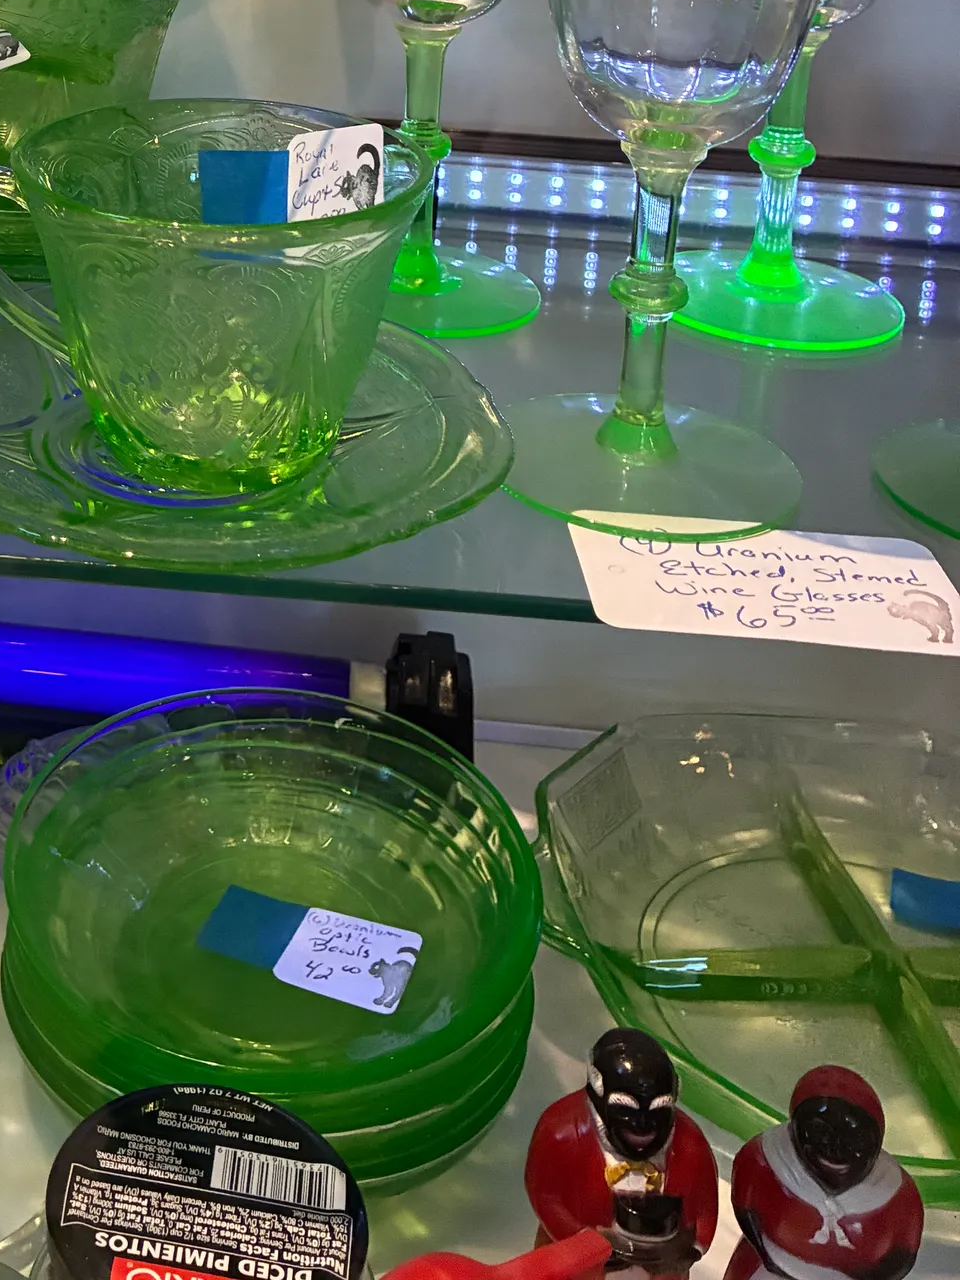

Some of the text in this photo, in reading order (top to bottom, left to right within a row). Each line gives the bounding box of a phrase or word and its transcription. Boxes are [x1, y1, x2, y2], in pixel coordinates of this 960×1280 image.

[293, 141, 334, 166] Royal
[694, 540, 858, 565] Uranium
[812, 567, 928, 588] Stemed
[653, 579, 886, 604] Wine Glasses
[308, 937, 371, 959] Bowls
[251, 1098, 274, 1112] NET
[177, 1113, 187, 1121] FL
[192, 1104, 256, 1123] PRODUCT OF PERU
[205, 1117, 227, 1129] PLANT
[120, 1131, 157, 1145] CHOOSING
[156, 1116, 300, 1150] DISTRIBUTED BY: MARIO CAMACHO FOODS
[157, 1138, 172, 1148] FOR
[172, 1141, 188, 1151] YOU
[188, 1143, 212, 1155] THANK
[116, 1146, 182, 1165] PLEASE CALL US AT
[137, 1158, 148, 1167] OR
[148, 1159, 189, 1175] COMMENTS
[98, 1158, 198, 1185] SATISFACTION GUARANTEED.
[189, 1167, 205, 1178] FOR
[91, 1180, 112, 1191] based
[114, 1193, 148, 1207] Protein
[140, 1189, 163, 1200] Values
[163, 1192, 181, 1204] Daily
[114, 1201, 148, 1215] Sodium
[160, 1200, 183, 1213] Sugars
[180, 1196, 207, 1209] Percent
[222, 1204, 236, 1214] Iron
[67, 1208, 100, 1223] Container
[100, 1216, 113, 1226] Per
[126, 1212, 141, 1222] Fat
[143, 1216, 166, 1227] Total
[250, 1209, 278, 1222] Calcium
[306, 1212, 329, 1224] calorie
[114, 1217, 144, 1232] Servings
[192, 1225, 208, 1235] Fat
[195, 1216, 247, 1233] Cholesterol
[304, 1219, 330, 1232] Vitamin
[169, 1227, 183, 1237] cup
[183, 1231, 194, 1241] 1/2
[196, 1234, 211, 1243] size
[219, 1230, 257, 1244] Calories
[271, 1231, 290, 1242] Trans
[307, 1229, 332, 1241] Total
[211, 1234, 239, 1249] Serving
[284, 1242, 296, 1252] Per
[331, 1240, 348, 1252] Fat
[93, 1230, 231, 1273] PIMIENTOS
[238, 1243, 280, 1261] Facts
[296, 1244, 321, 1256] Amount
[282, 1249, 346, 1275] Nutrition
[237, 1258, 313, 1280] DICED
